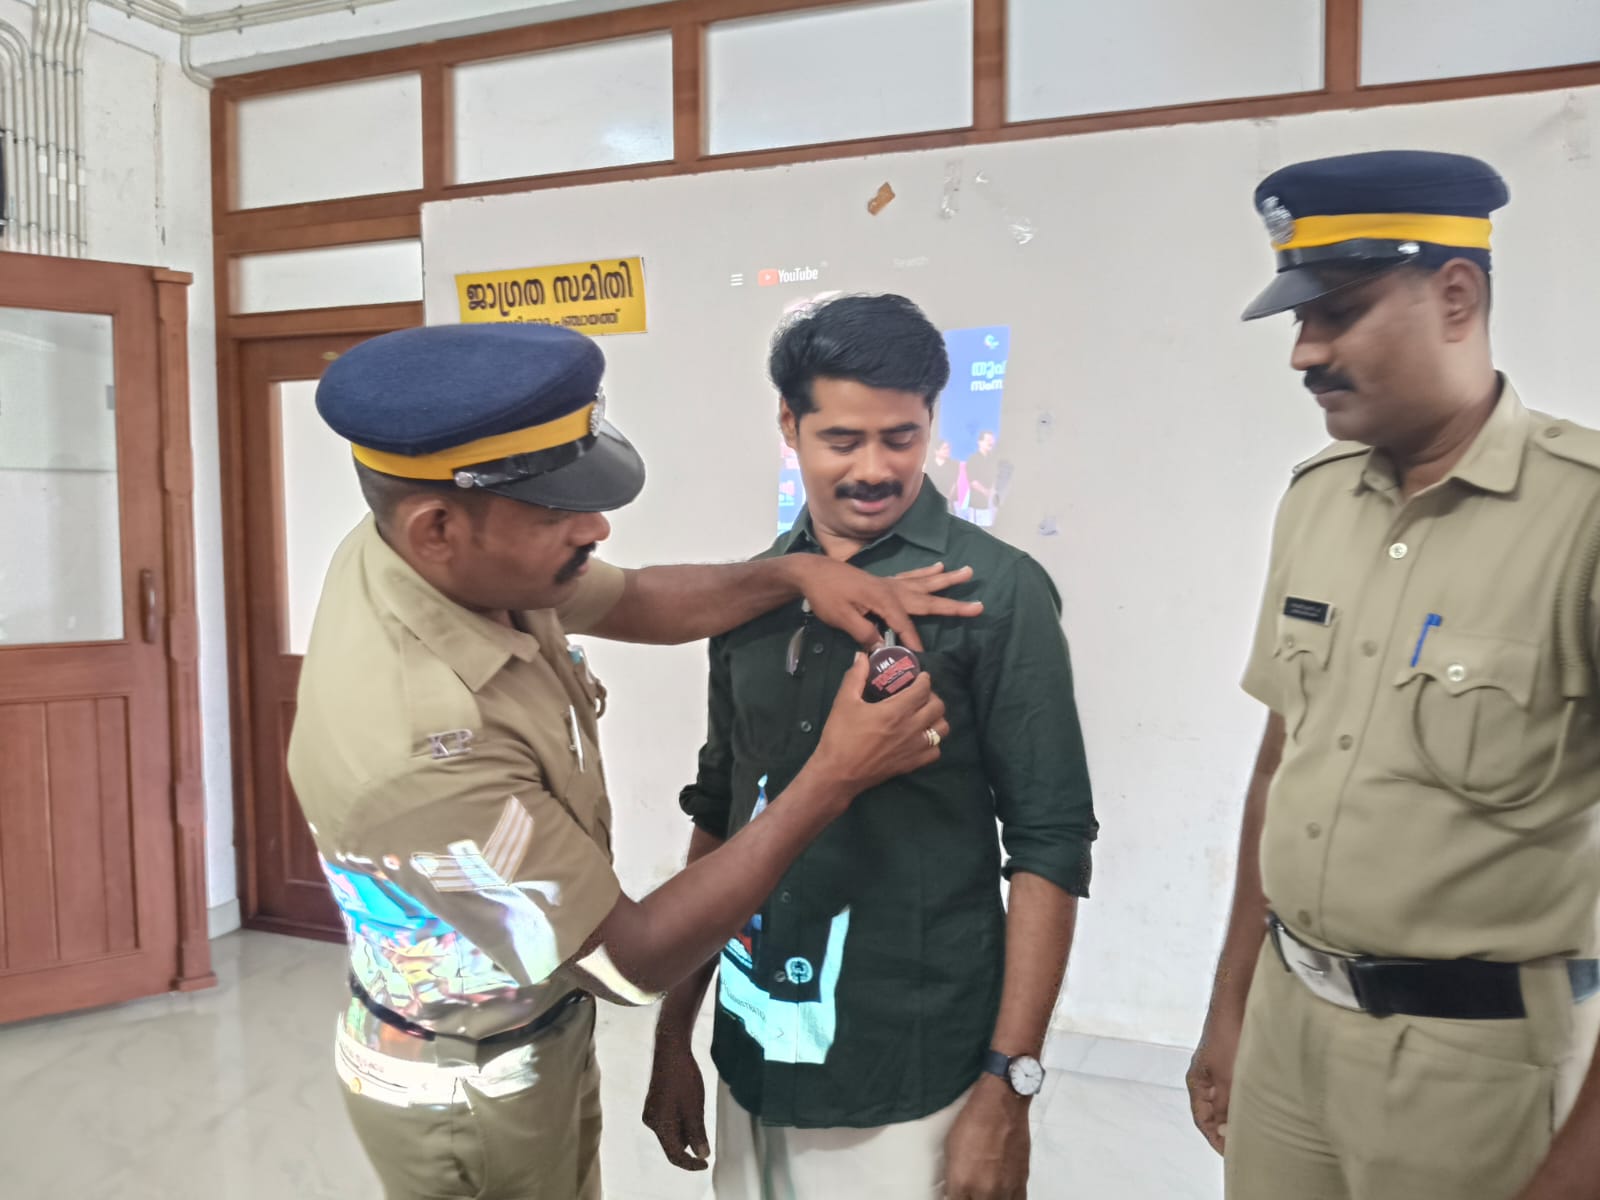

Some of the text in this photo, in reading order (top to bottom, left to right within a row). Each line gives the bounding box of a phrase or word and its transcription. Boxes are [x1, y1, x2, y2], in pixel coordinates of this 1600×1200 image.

[467, 261, 634, 317] ജാഗ്രത സമിതി
[778, 266, 819, 284] YouTube
[428, 728, 473, 760] KP
